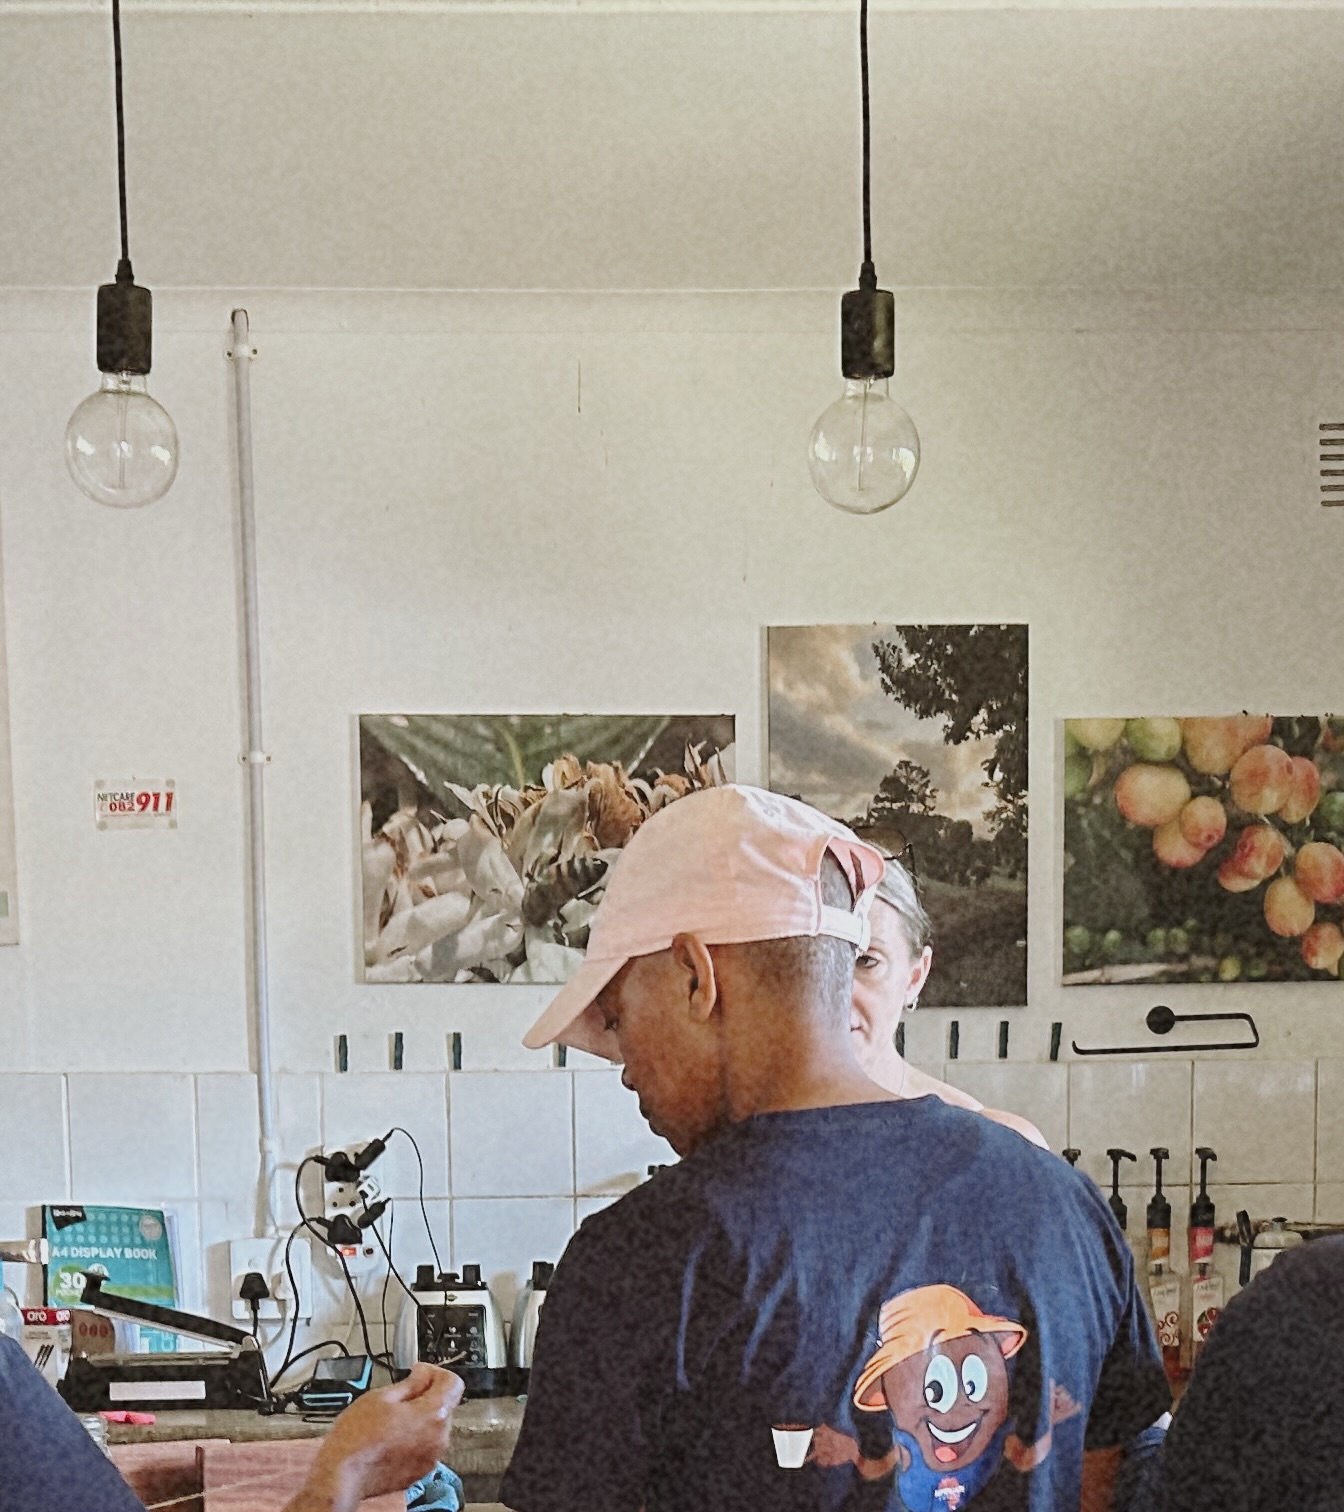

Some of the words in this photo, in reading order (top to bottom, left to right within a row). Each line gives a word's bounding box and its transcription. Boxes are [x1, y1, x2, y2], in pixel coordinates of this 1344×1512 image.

[109, 802, 135, 812] 082
[136, 792, 173, 812] 911
[52, 1247, 67, 1258] A4
[71, 1248, 122, 1259] DISPLAY
[125, 1248, 157, 1260] BOOK
[58, 1272, 87, 1289] 30
